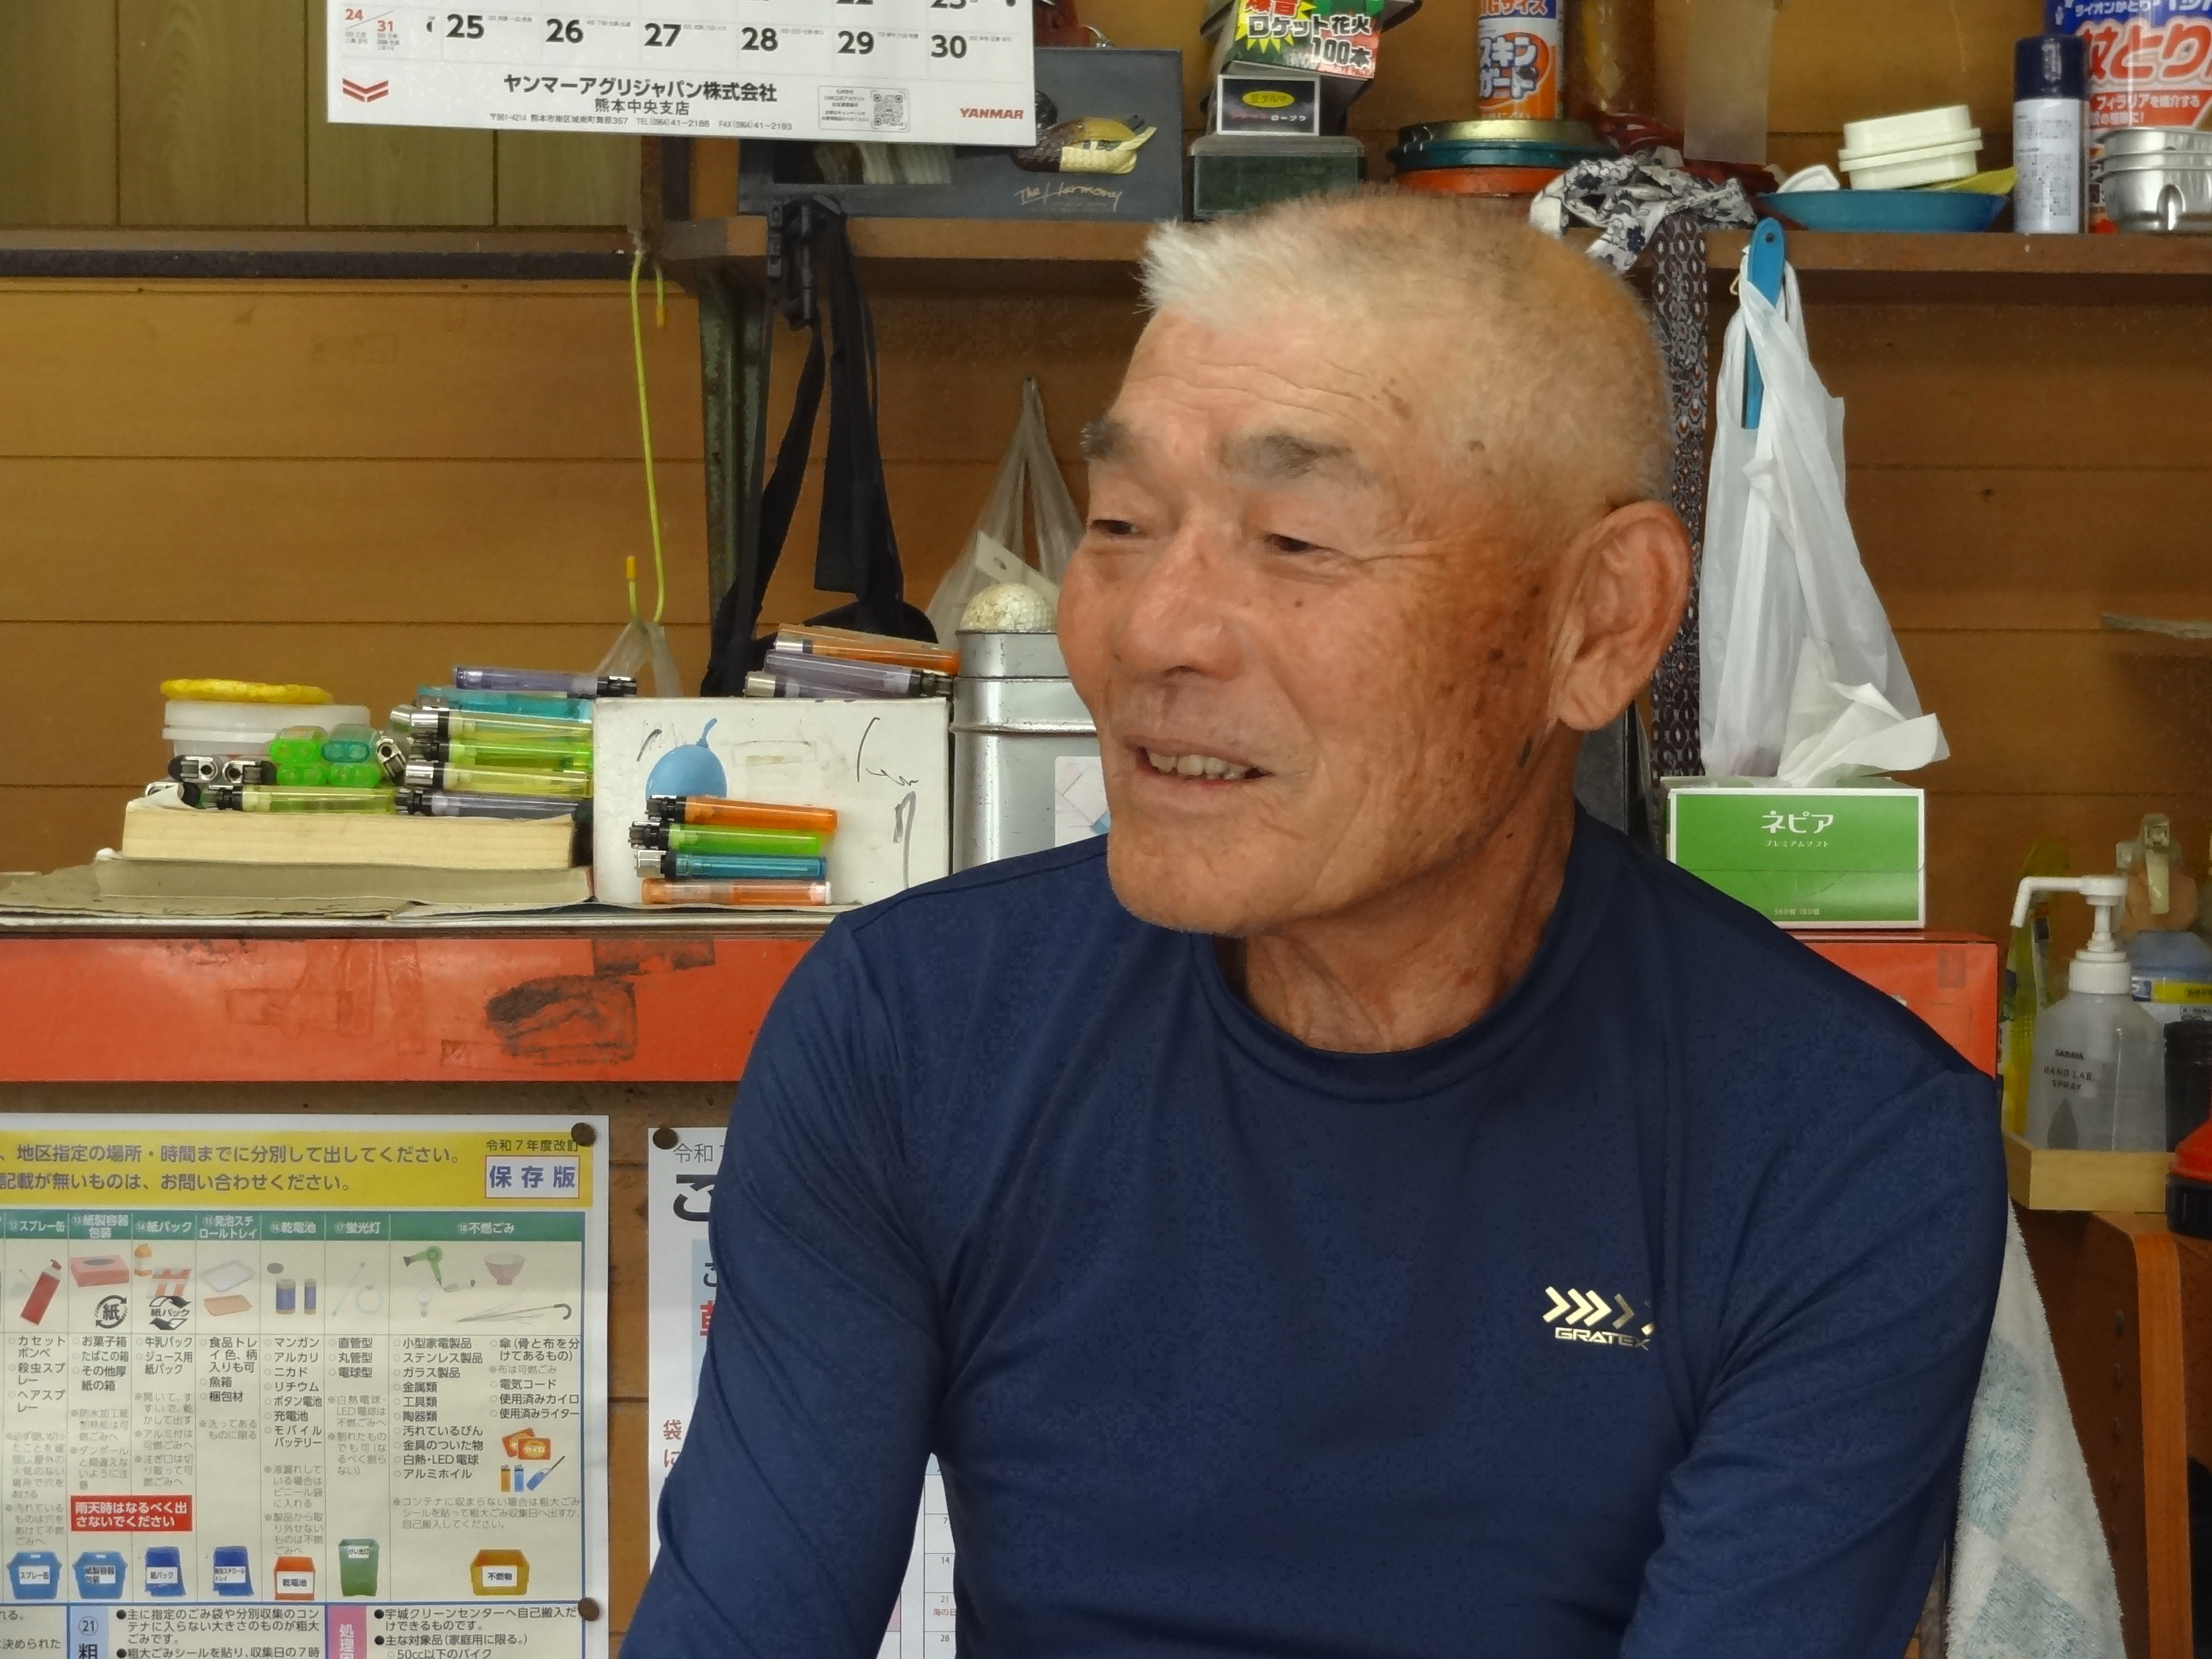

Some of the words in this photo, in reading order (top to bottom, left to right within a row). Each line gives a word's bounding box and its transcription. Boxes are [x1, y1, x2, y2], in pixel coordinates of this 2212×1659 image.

[344, 8, 364, 21] 24
[377, 21, 394, 32] 31
[446, 14, 484, 39] 25
[546, 19, 584, 43] 26
[1248, 14, 1372, 38] ロケット花火
[644, 23, 682, 47] 27
[741, 27, 779, 52] 28
[837, 30, 875, 55] 29
[931, 35, 967, 58] 30
[1311, 36, 1372, 69] 100本
[504, 74, 777, 102] ヤンマーアグリジャパン株式会社
[594, 98, 689, 115] 熊本中央支店
[959, 107, 1024, 121] YANMAR
[1041, 182, 1122, 212] Harmony
[1761, 810, 1833, 834] ネピア
[672, 1143, 726, 1164] 令和
[489, 1165, 576, 1189] 保存版
[89, 1227, 113, 1239] 包装
[199, 1228, 257, 1239] ロールトレイ
[102, 1304, 121, 1321] 紙
[150, 1308, 190, 1317] 紙パック
[18, 1336, 65, 1346] カセット
[82, 1336, 127, 1347] お菓子箱
[145, 1336, 192, 1348] 牛乳パック
[209, 1336, 257, 1348] 食品トレ
[274, 1337, 320, 1348] マンガン
[338, 1337, 373, 1349] 直管型
[403, 1338, 472, 1349] 小型家電製品
[499, 1338, 580, 1349] 傘(骨と布を分
[1555, 1327, 1651, 1351] GRATEX
[18, 1347, 50, 1358] ボンベ
[81, 1350, 129, 1362] たばこの箱
[146, 1351, 193, 1362] ジュース用
[274, 1352, 318, 1362] アルカリ
[338, 1352, 373, 1363] 丸管型
[403, 1352, 483, 1364] ステンレス製品
[500, 1350, 573, 1362] けてあるもの)
[82, 1366, 127, 1377] その他厚
[144, 1364, 183, 1375] 紙パック
[209, 1362, 255, 1373] 入りも可
[274, 1367, 307, 1378] ニカド
[338, 1367, 373, 1378] 電球型
[403, 1367, 460, 1378] ガラス製品
[18, 1375, 38, 1385] レー
[81, 1379, 116, 1392] 紙の箱
[209, 1376, 232, 1388] 魚箱
[499, 1378, 557, 1390] 電気コード
[275, 1381, 319, 1392] リチウム
[403, 1381, 438, 1393] 金属類
[18, 1389, 65, 1401] ヘアスプ
[209, 1391, 244, 1403] 梱包材
[499, 1393, 579, 1405] 使用済みカイロ
[18, 1403, 38, 1412] レー
[274, 1396, 322, 1407] ボタン電池
[403, 1396, 438, 1408] 工具類
[274, 1410, 309, 1421] 充電池
[403, 1410, 438, 1422] 陶器類
[499, 1407, 580, 1419] 使用済みライター
[274, 1425, 322, 1436] モバイル
[403, 1425, 483, 1436] 汚れているびん
[663, 1419, 683, 1440] 袋
[275, 1436, 323, 1448] バッテリー
[403, 1439, 483, 1451] 金具のついた物
[403, 1469, 472, 1480] アルミホイル
[75, 1502, 187, 1514] 雨天時はなるべく出
[274, 1499, 312, 1509] に入れる
[76, 1516, 175, 1527] さないでください
[127, 1608, 320, 1620] 主に指定のごみ袋や分別収集のコン
[385, 1607, 577, 1620] 宇城グリーンセンターへ自己搬入だ
[128, 1621, 320, 1632] テナに入らない大きさのものが粗大
[386, 1620, 483, 1631] けできるものです。
[0, 1638, 61, 1650] 決められた
[128, 1634, 179, 1645] ごみです。
[397, 1649, 492, 1659] 50cc以下のバイク
